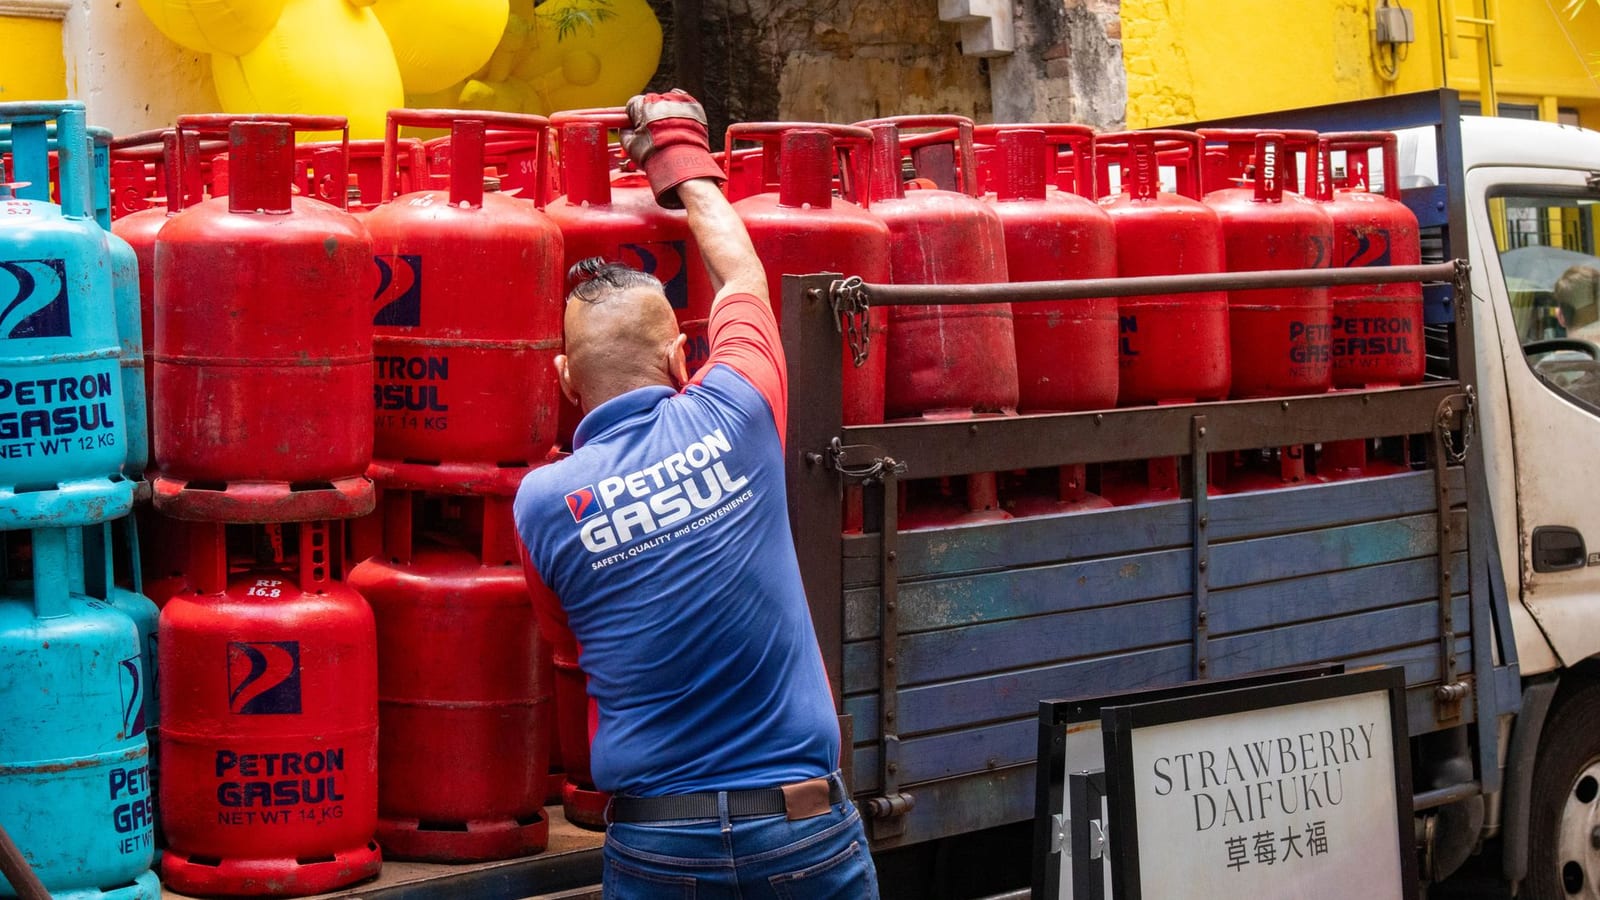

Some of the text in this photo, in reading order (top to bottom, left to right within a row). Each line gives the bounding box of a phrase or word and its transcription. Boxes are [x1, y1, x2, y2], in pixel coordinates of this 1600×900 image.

[1332, 317, 1412, 334] PETRON
[1332, 337, 1411, 356] GASUL
[0, 372, 112, 406] PETRON
[0, 402, 114, 440] GASUL
[424, 416, 447, 430] KG
[40, 438, 72, 456] WT
[79, 436, 94, 450] 12
[97, 433, 115, 448] KG
[598, 429, 732, 509] PETRON
[580, 461, 749, 553] GASUL
[592, 490, 754, 570] SAFETY, QUALITY and CONVENIENCE
[247, 587, 281, 598] 16.8
[216, 748, 344, 777] PETRON
[1153, 723, 1375, 796] STRAWBERRY
[217, 777, 344, 807] GASUL
[1193, 768, 1343, 832] DAIFUKU
[218, 805, 343, 825] NET WT 14 KG
[1225, 820, 1329, 872] 草莓大福
